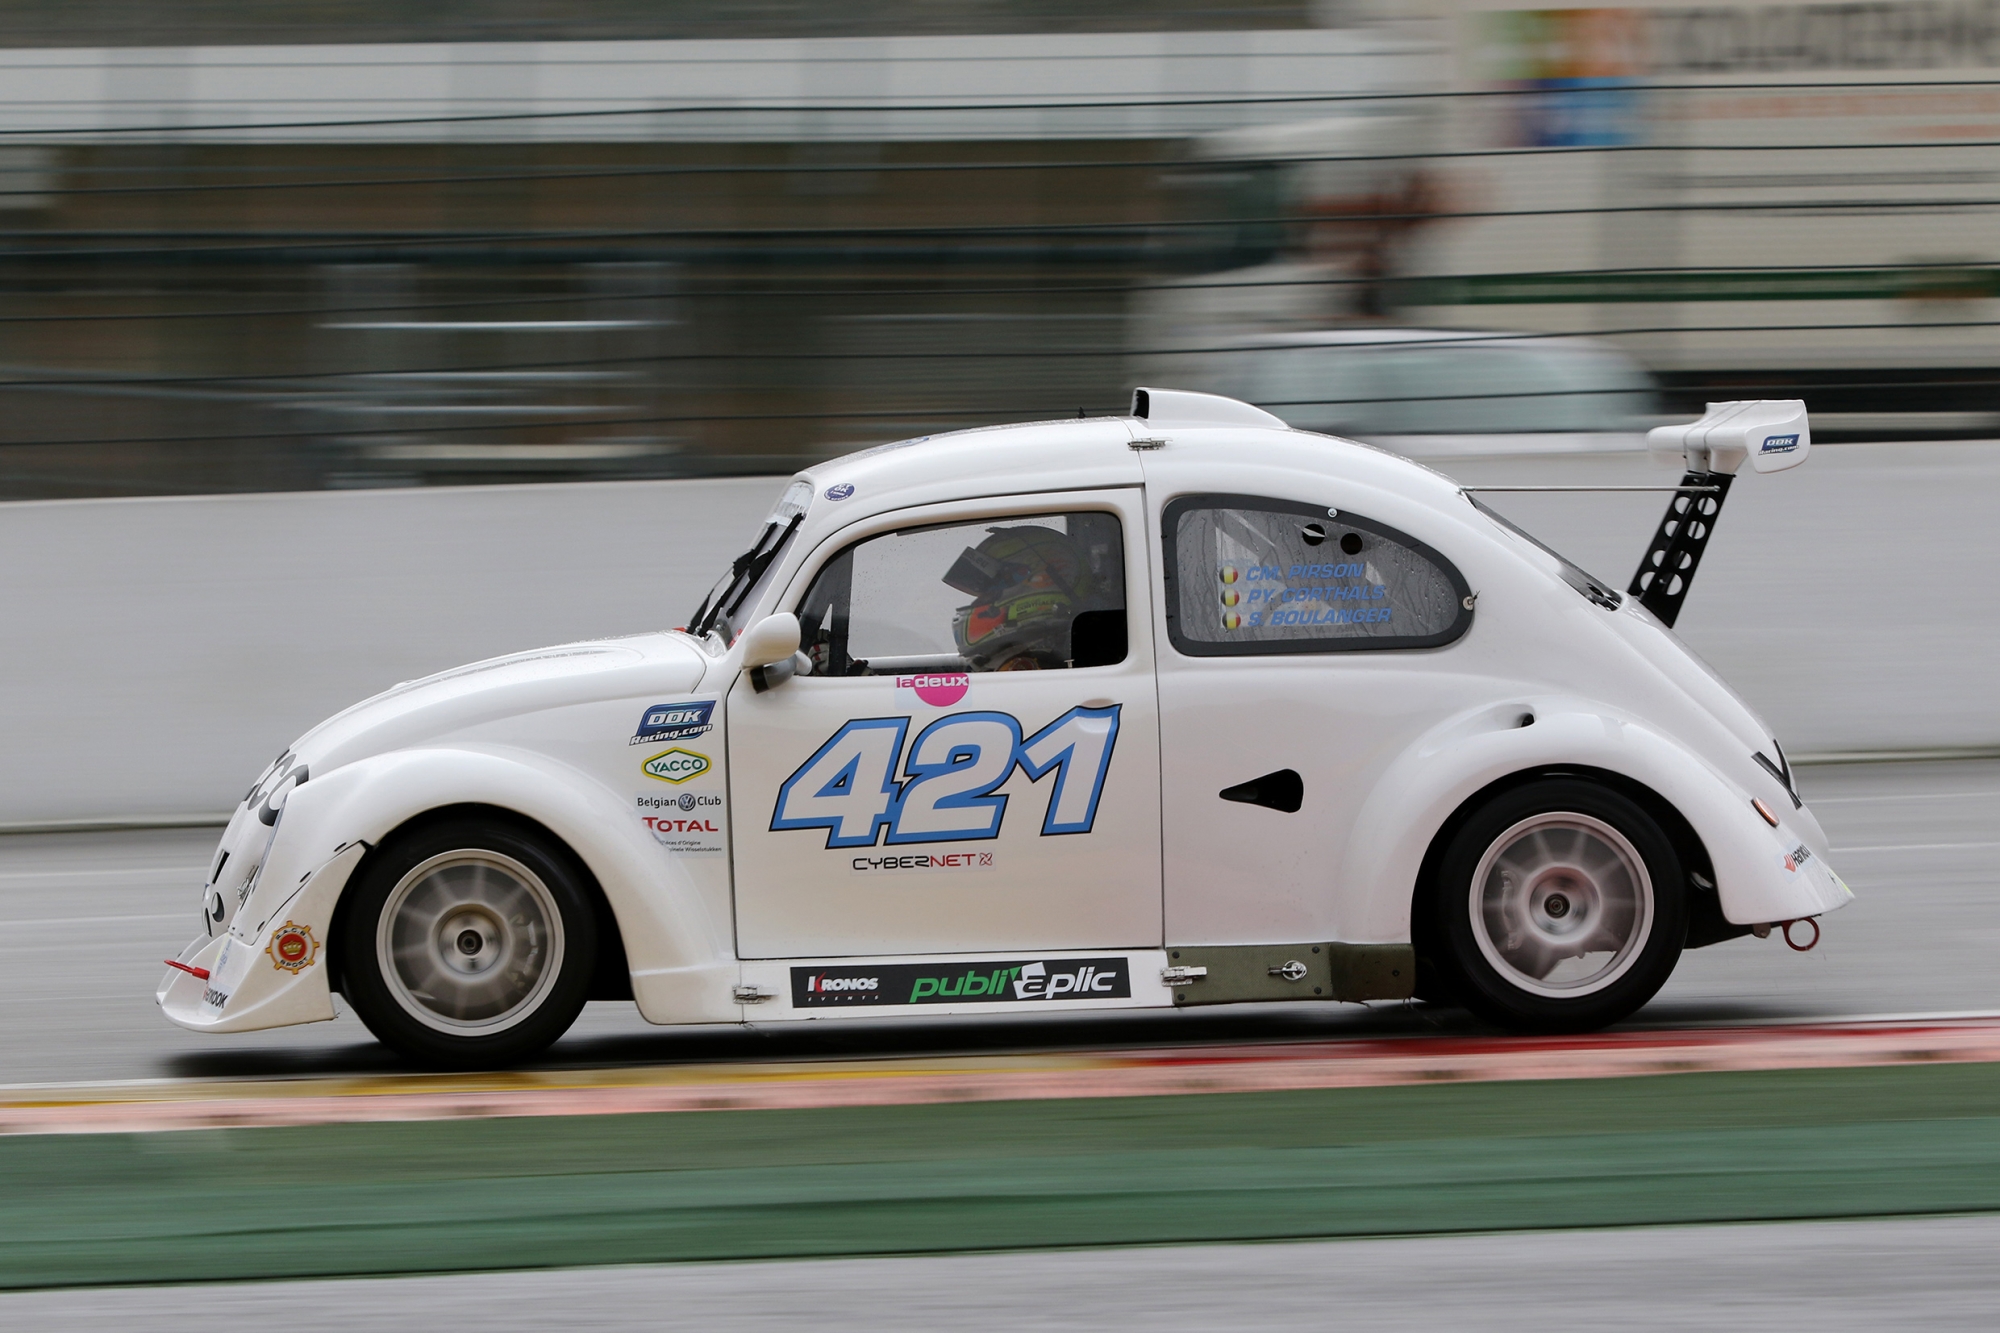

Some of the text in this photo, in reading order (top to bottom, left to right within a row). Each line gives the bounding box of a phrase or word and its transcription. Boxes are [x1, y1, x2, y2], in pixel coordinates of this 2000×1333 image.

[1246, 562, 1364, 581] CM. PIRSON
[1281, 585, 1386, 603] CORTHALS
[1248, 607, 1392, 627] S. BOULANGER
[646, 710, 702, 726] DDK
[629, 724, 713, 745] Racing.com
[650, 758, 703, 773] YACCO
[768, 703, 1123, 849] 421
[637, 797, 676, 809] Belgian
[697, 796, 722, 806] Club
[642, 816, 719, 833] TOTAL
[807, 971, 879, 993] KRONOS
[808, 994, 879, 1002] EVENTS
